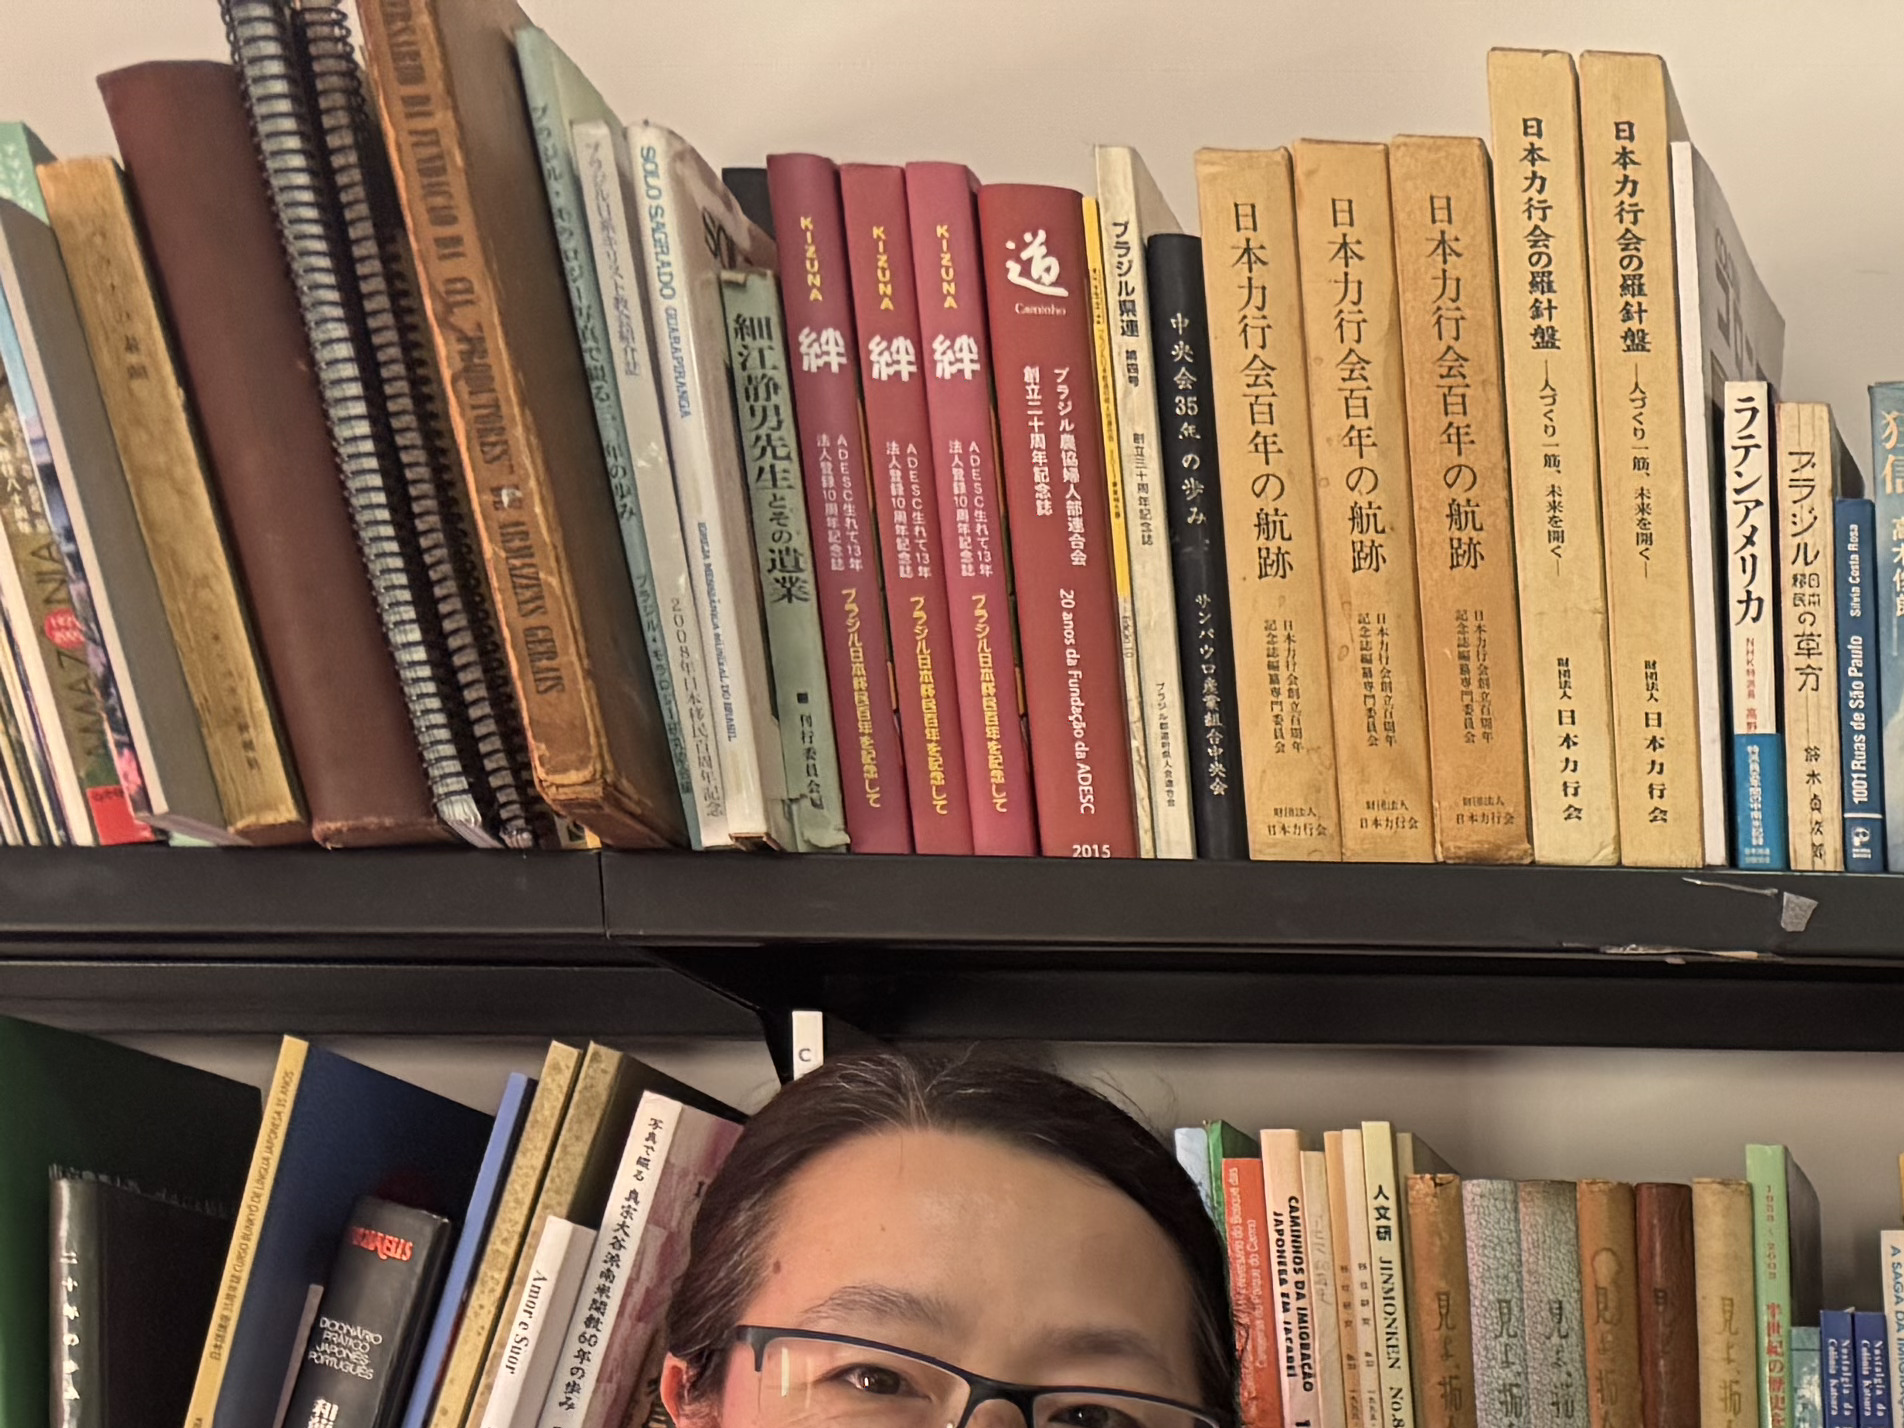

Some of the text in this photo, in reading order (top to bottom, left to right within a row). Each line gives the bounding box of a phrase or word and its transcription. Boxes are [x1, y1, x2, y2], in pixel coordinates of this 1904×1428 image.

[800, 216, 823, 302] KIZUNA
[872, 226, 894, 311] KIZUNA
[936, 225, 958, 310] KIZUNA
[799, 326, 848, 373] 絆
[868, 334, 917, 382] 絆
[932, 334, 981, 381] 絆
[1732, 396, 1766, 627] ラテンアメリカ
[1062, 612, 1096, 815] anos Fundação ADESC
[1557, 708, 1583, 822] 日本力行会
[1847, 635, 1868, 805] 1001 Ruas de São Paulo
[1643, 711, 1669, 824] 日本力行会
[505, 1270, 549, 1375] Amor Suor
[1379, 1256, 1402, 1370] JINMONKEN
